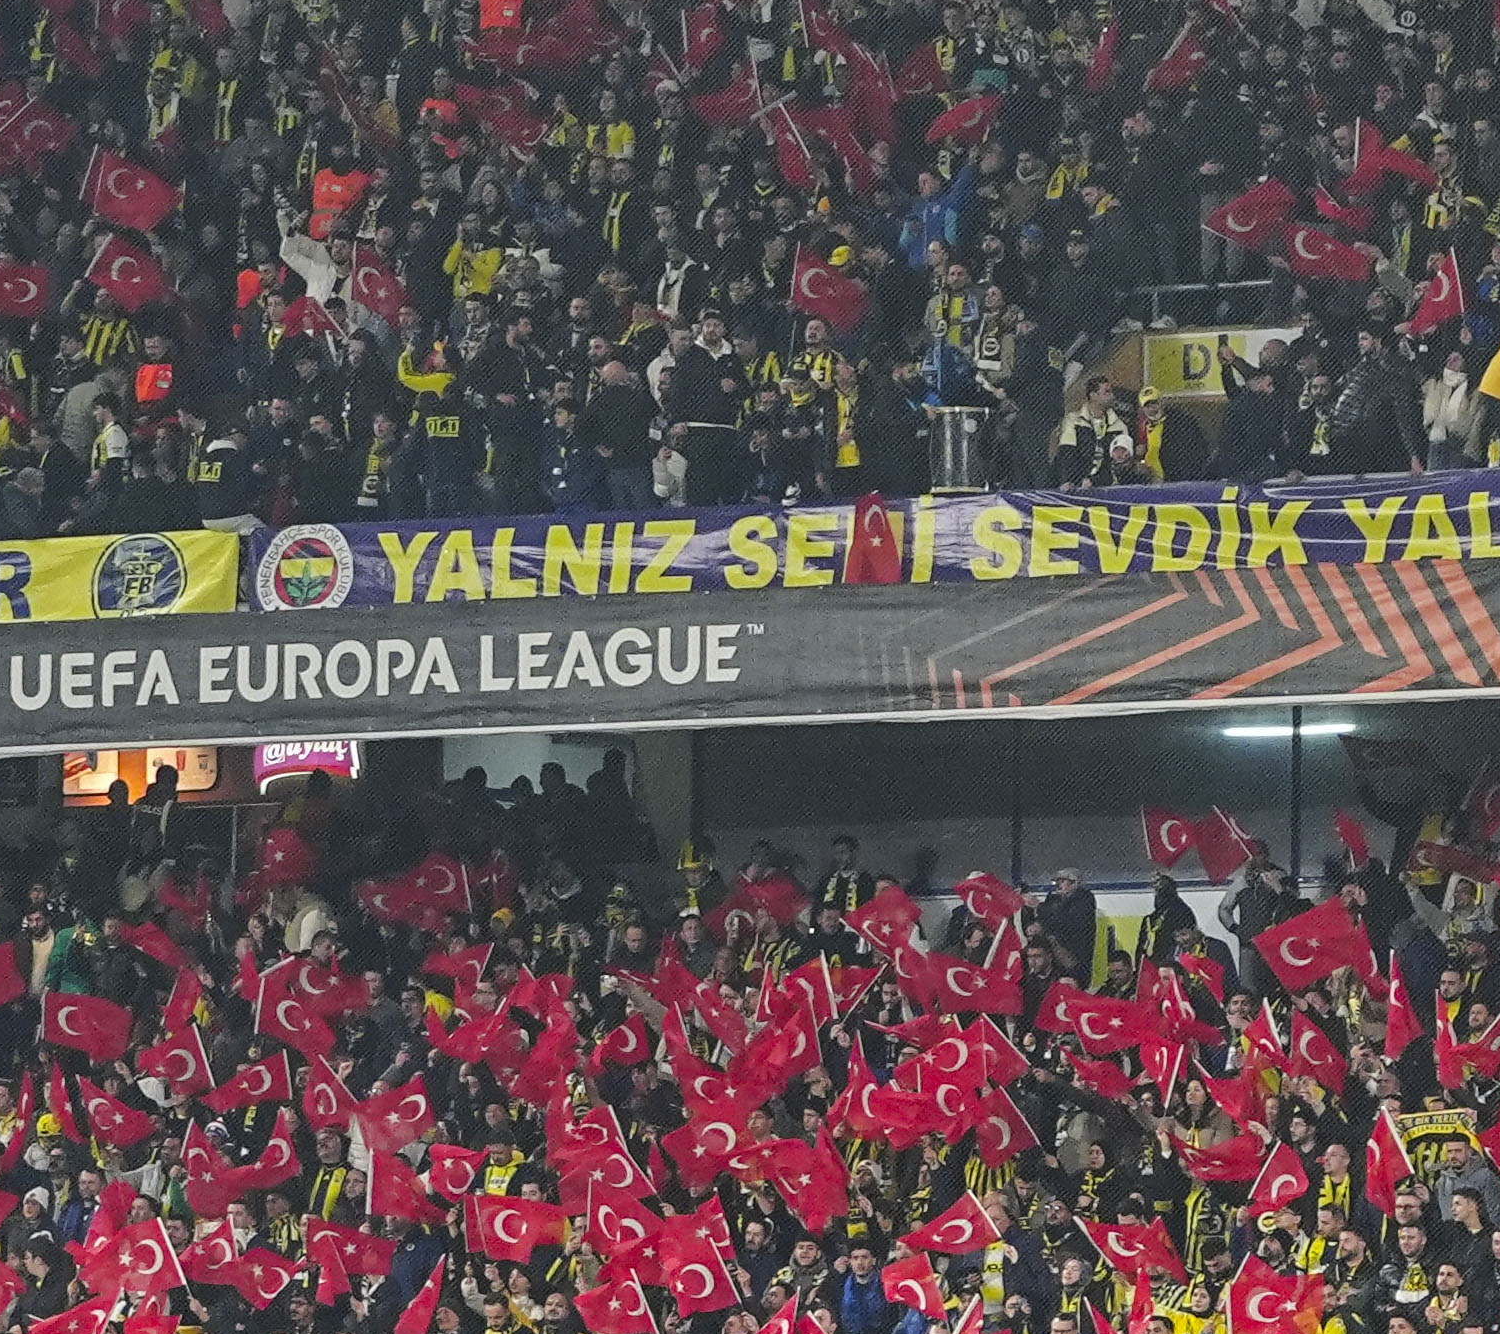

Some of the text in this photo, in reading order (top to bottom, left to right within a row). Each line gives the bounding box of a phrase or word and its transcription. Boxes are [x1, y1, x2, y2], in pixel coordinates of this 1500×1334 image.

[378, 518, 697, 605] YALNIZ
[723, 494, 935, 589] SEİ
[970, 485, 1313, 581] SEVDİK
[8, 649, 181, 711] UEFA
[198, 636, 461, 705] EUROPA
